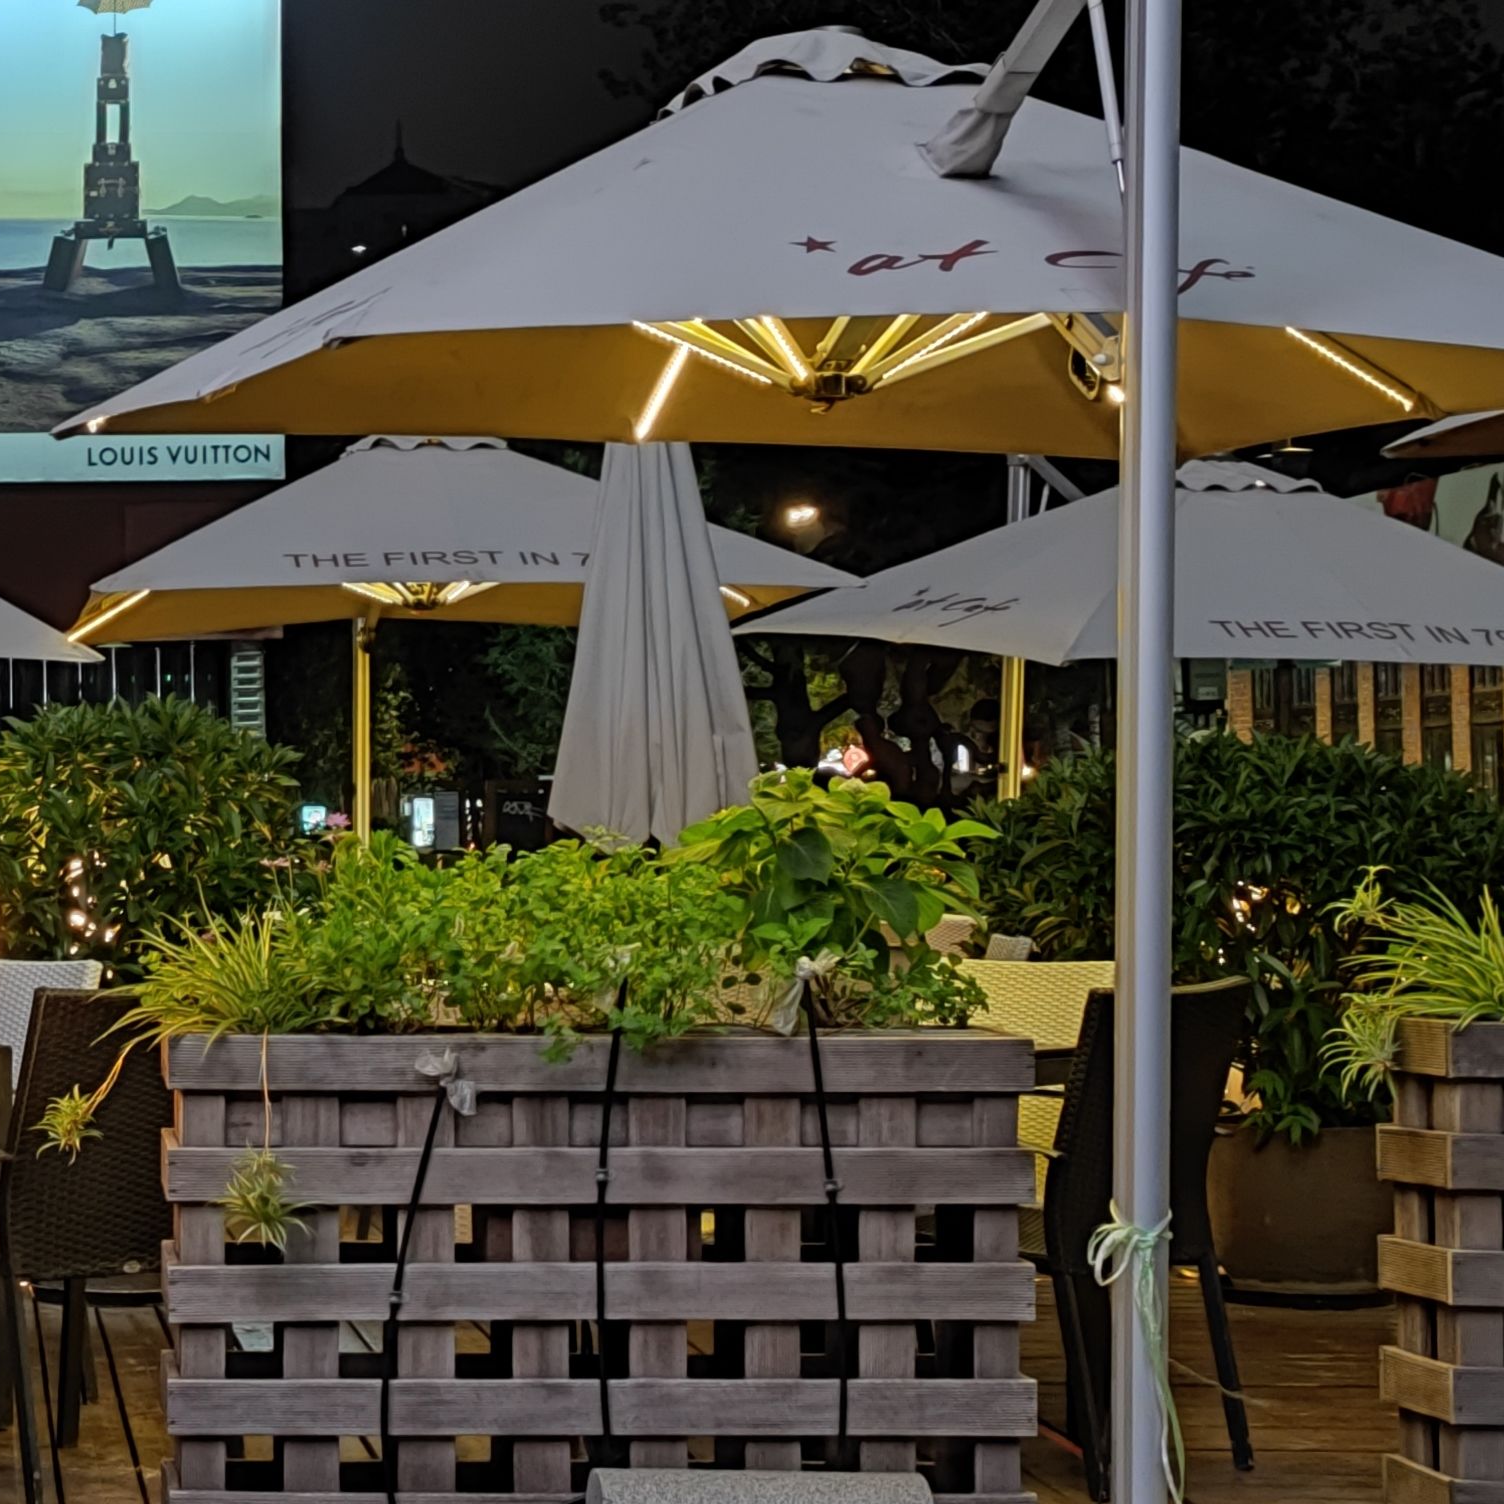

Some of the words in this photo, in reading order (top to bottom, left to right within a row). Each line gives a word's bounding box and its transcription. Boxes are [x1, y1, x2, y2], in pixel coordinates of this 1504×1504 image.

[86, 445, 159, 467] LOUIS
[166, 443, 272, 466] VUITTON
[282, 552, 370, 569] THE
[382, 549, 504, 567] FIRST
[518, 550, 561, 567] IN
[1208, 619, 1298, 639] THE
[1299, 620, 1416, 643] FIRST
[1423, 624, 1471, 646] IN
